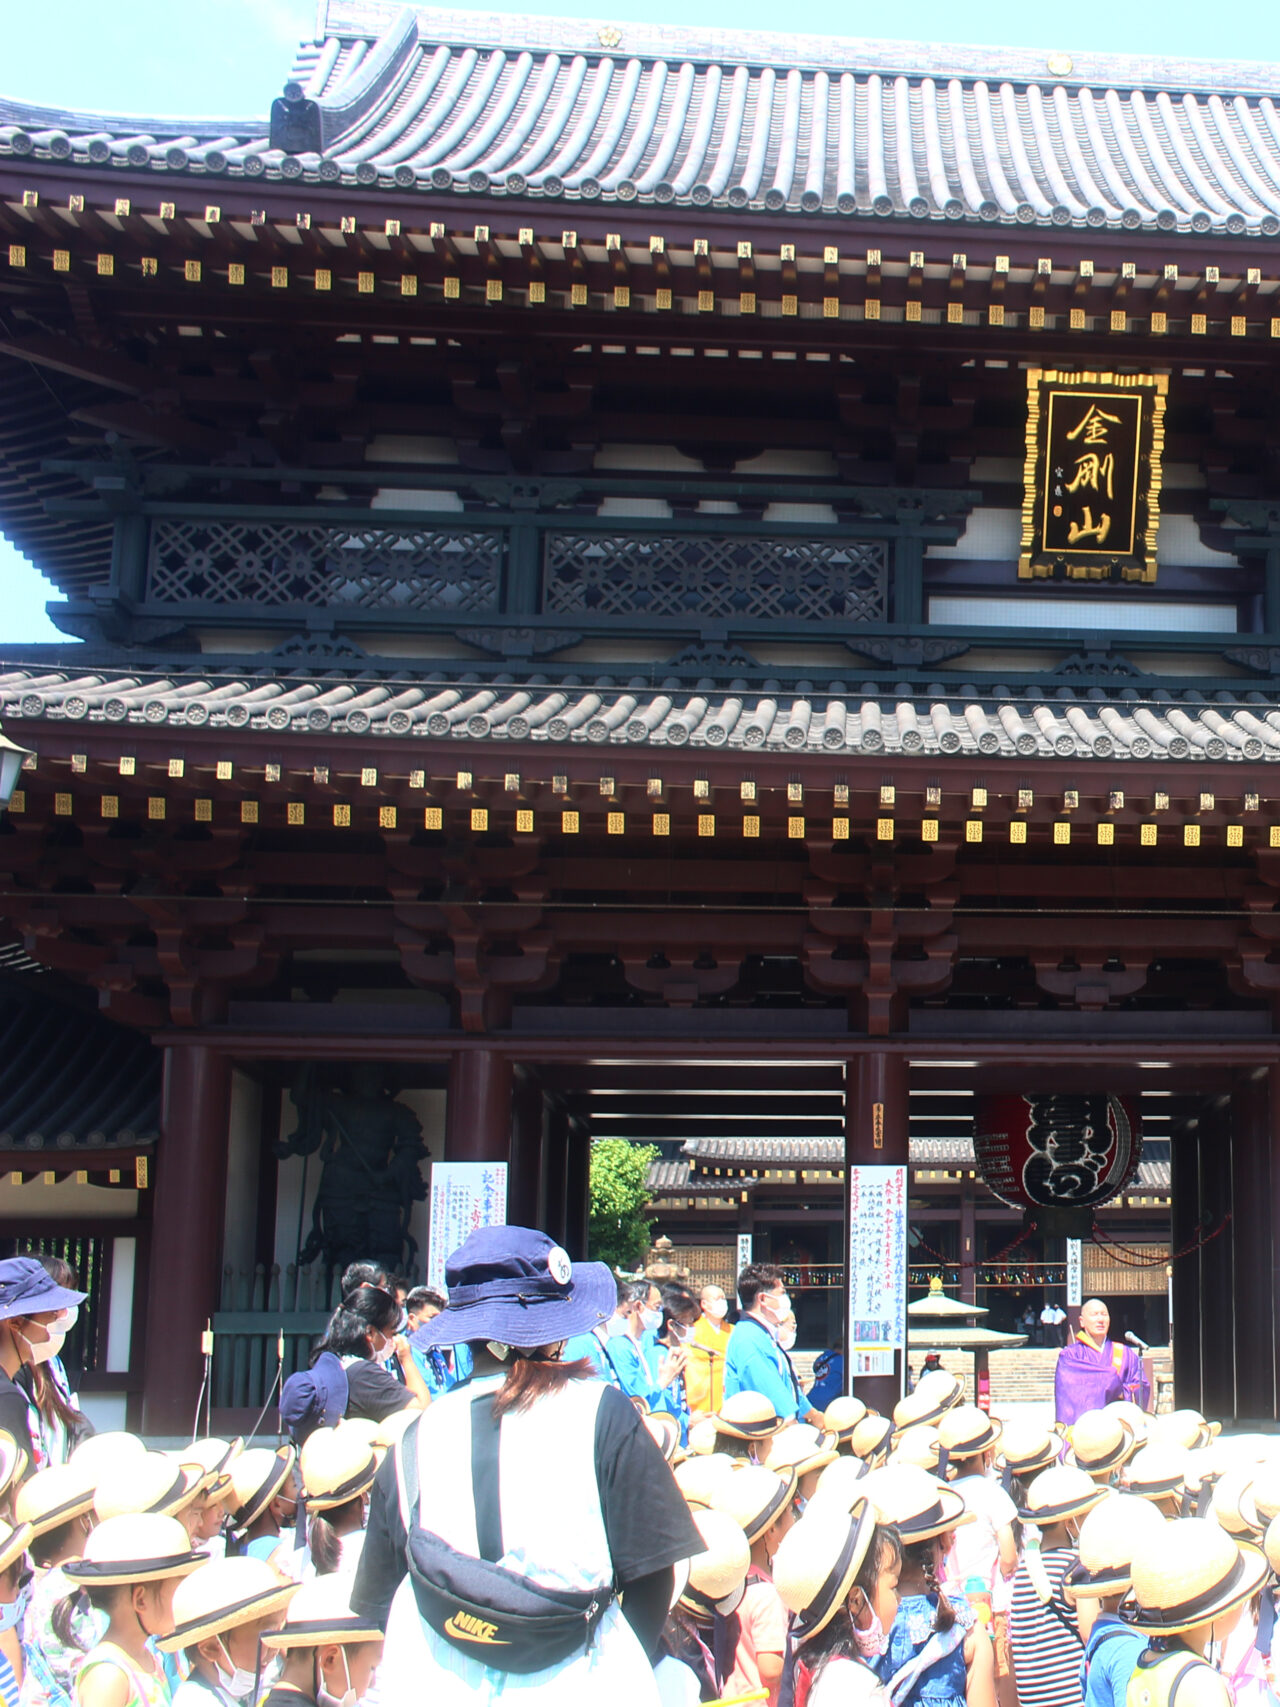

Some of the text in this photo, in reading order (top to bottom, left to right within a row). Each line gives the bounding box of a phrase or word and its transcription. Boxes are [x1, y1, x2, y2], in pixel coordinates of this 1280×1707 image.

[1065, 403, 1122, 544] 金剛山
[453, 1610, 500, 1641] NIKE
